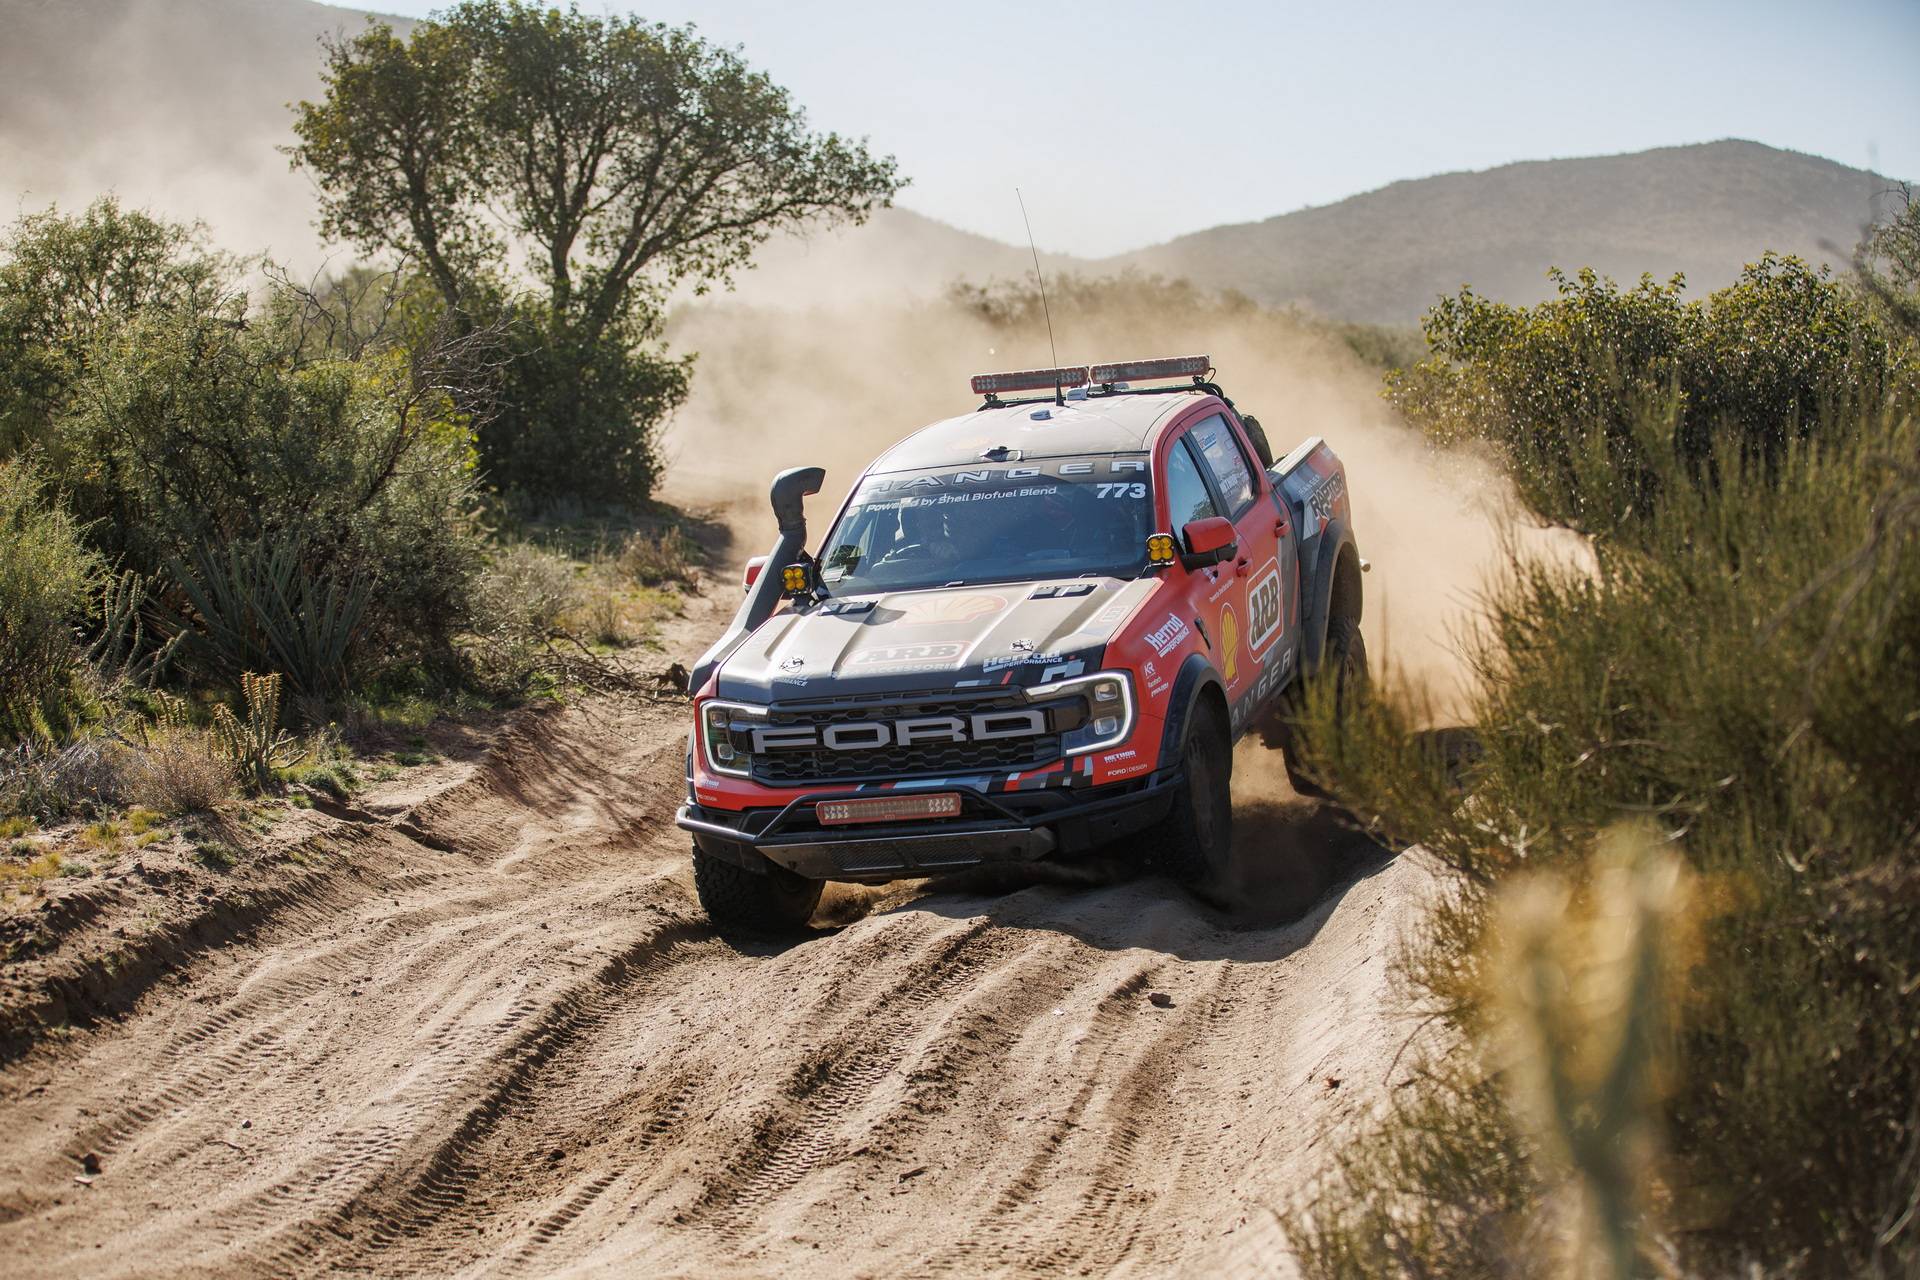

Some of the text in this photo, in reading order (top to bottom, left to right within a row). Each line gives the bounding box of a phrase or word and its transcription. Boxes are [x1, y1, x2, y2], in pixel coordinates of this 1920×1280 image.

[866, 486, 1057, 513] Powed by Shell Biofuel Blend
[1096, 482, 1146, 500] 773
[1250, 576, 1281, 646] ARB
[1144, 612, 1185, 651] Herrod
[855, 644, 960, 664] ARB
[983, 650, 1061, 668] Herrod
[1002, 656, 1063, 670] PERFORMANCE
[1232, 647, 1292, 726] ANGER
[752, 710, 1046, 754] FORD
[1107, 768, 1127, 777] FORD
